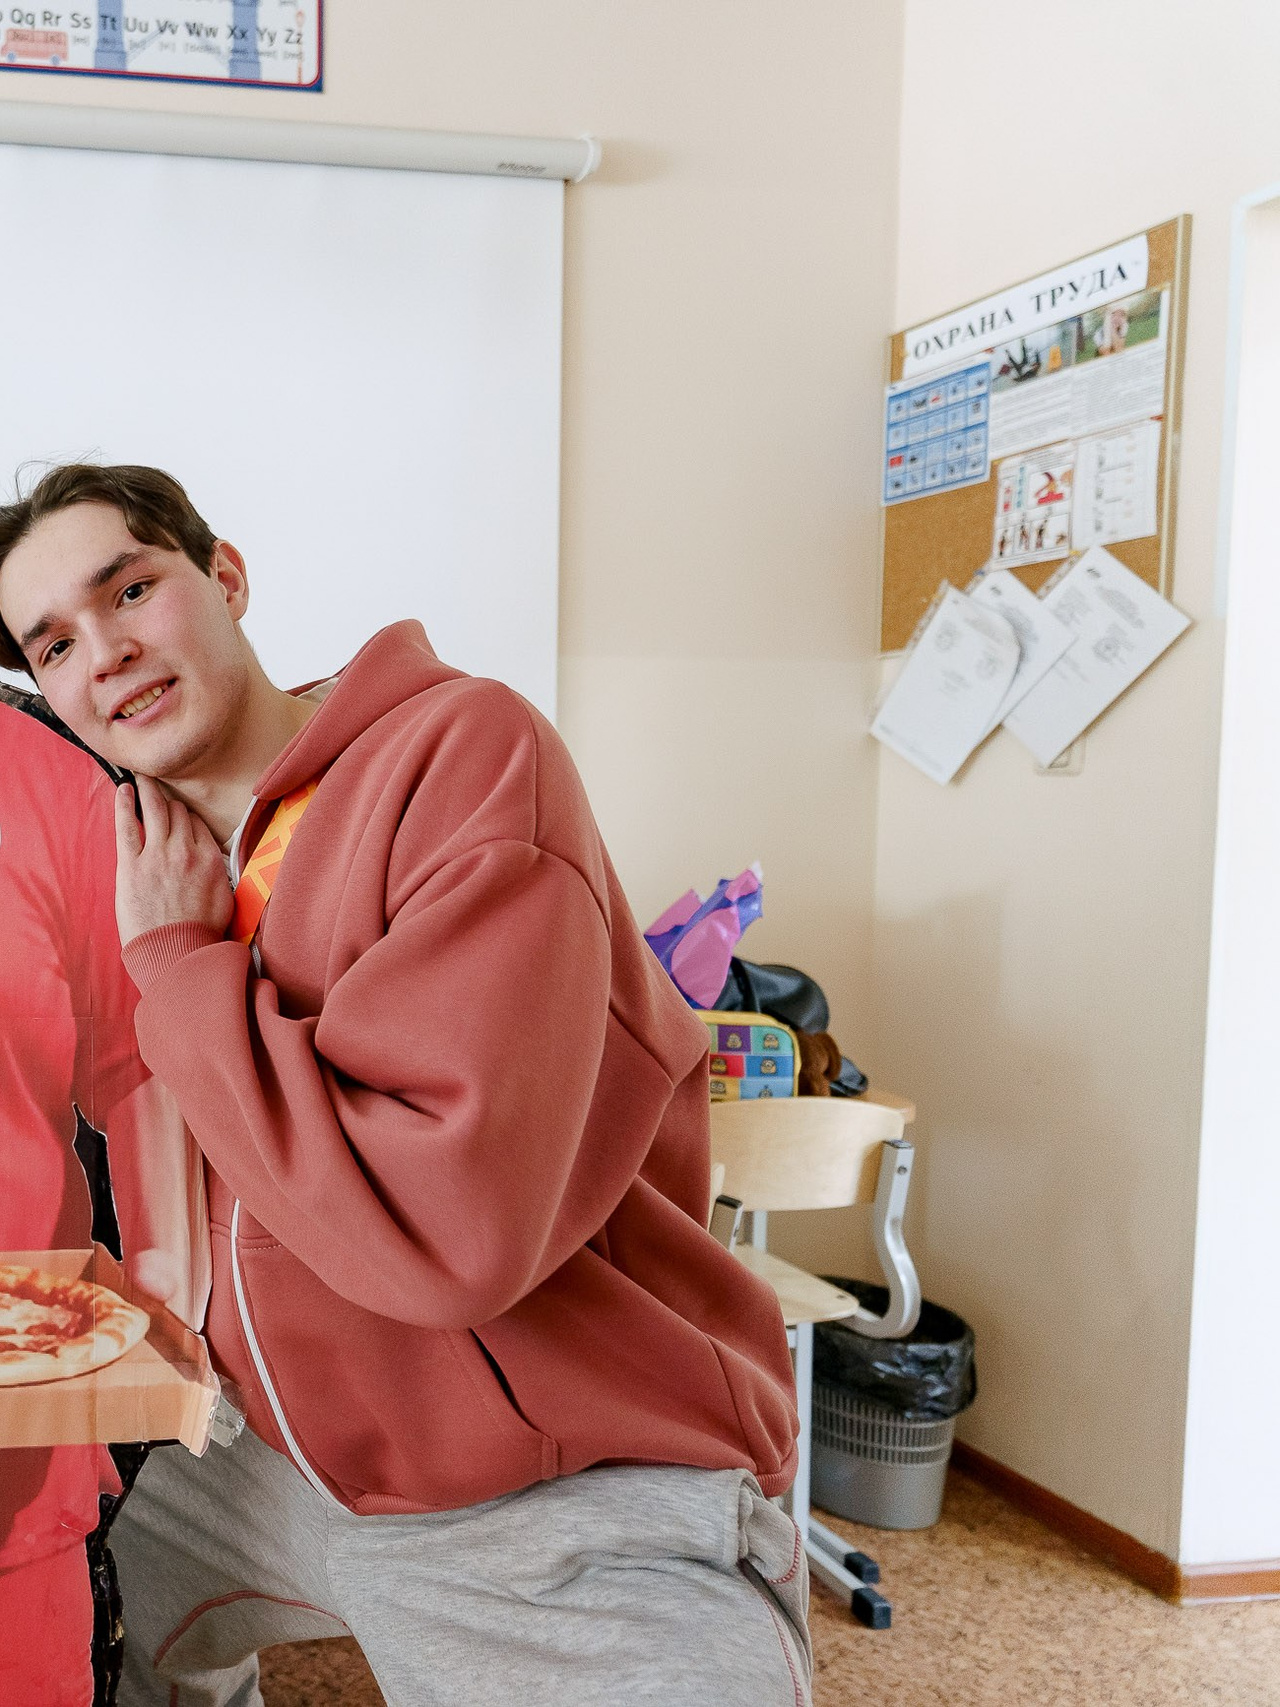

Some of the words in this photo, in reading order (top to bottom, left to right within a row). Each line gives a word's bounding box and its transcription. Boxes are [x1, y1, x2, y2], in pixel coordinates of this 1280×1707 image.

[11, 8, 35, 29] Qq
[43, 11, 61, 26] Rr
[70, 13, 92, 29] Ss
[101, 14, 117, 31] Tt
[125, 17, 148, 33] Uu
[157, 19, 179, 35] Vv
[185, 22, 218, 38] Ww
[227, 25, 249, 39] Xx
[256, 28, 277, 46] Yy
[284, 29, 303, 44] Zz
[913, 308, 1015, 360] ОХРАНА
[1030, 261, 1129, 314] ТРУДА
